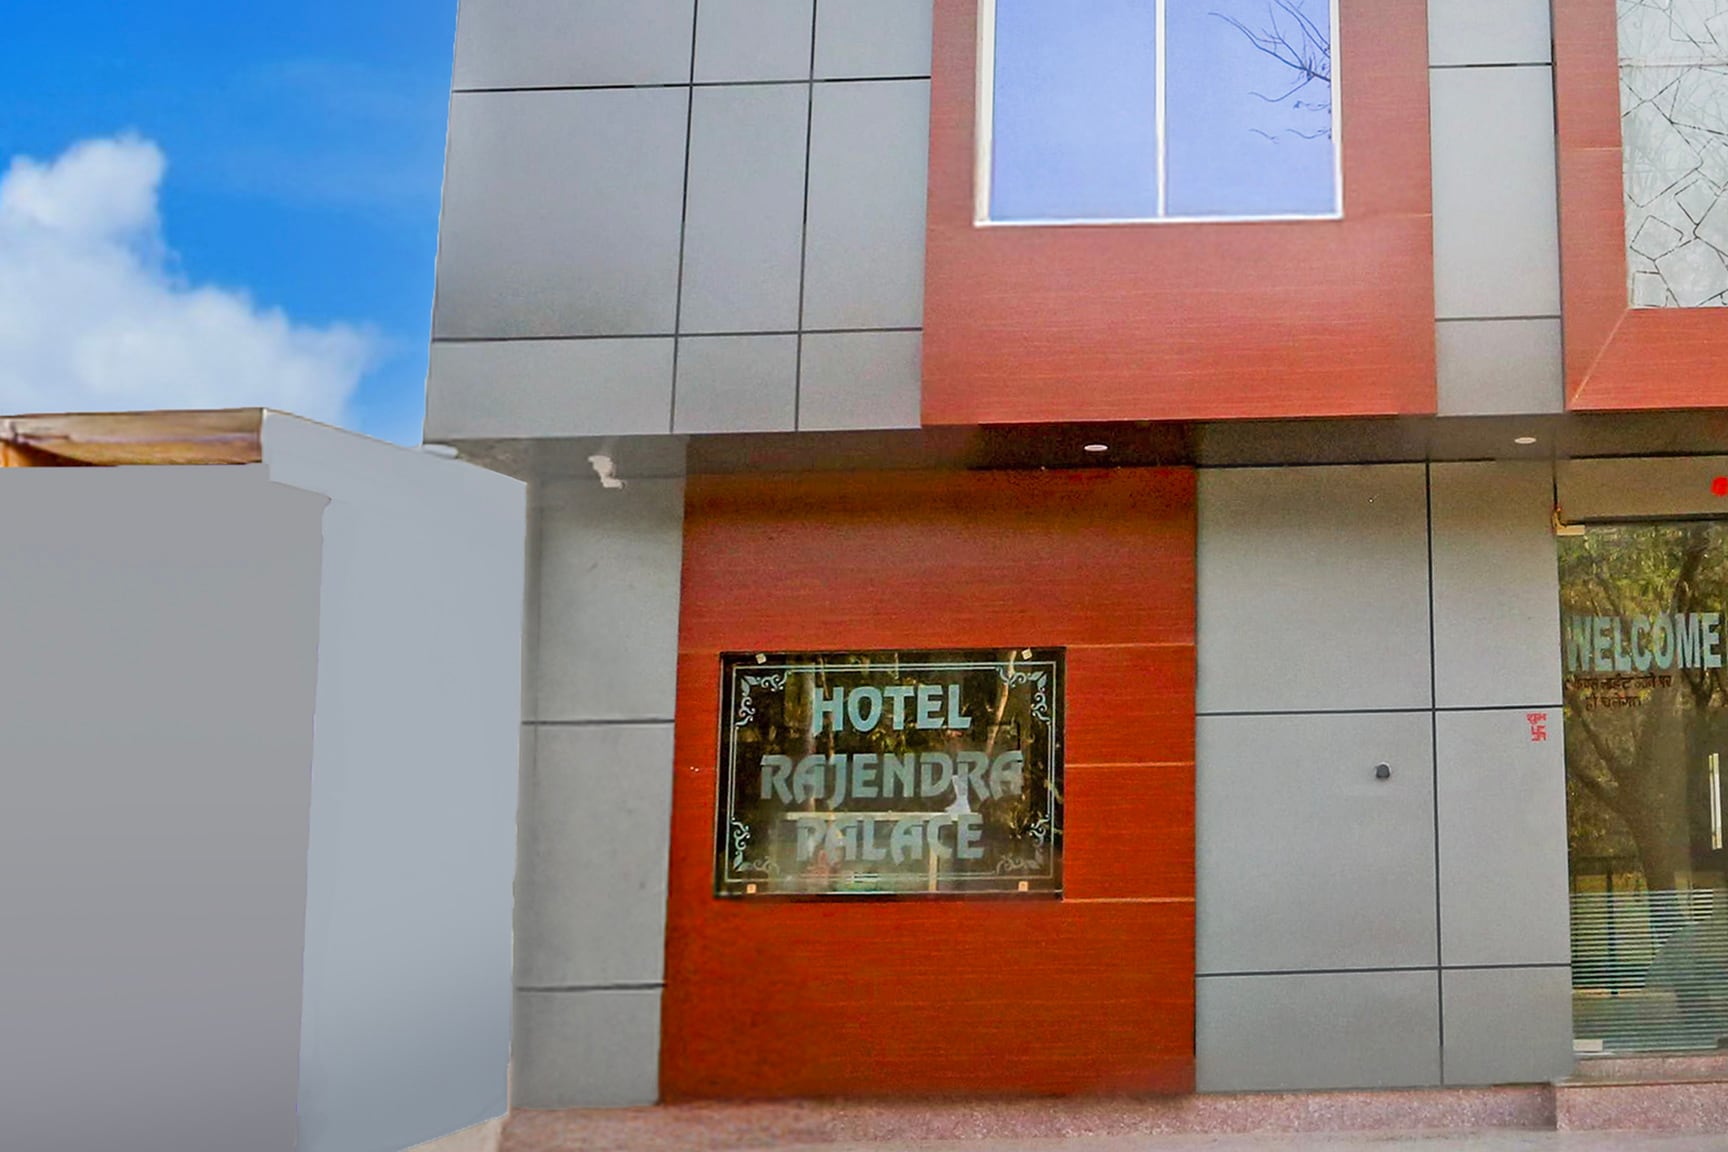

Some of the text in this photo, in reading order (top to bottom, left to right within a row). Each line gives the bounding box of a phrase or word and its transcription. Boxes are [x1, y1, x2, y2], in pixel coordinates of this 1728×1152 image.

[1565, 611, 1722, 672] WELCOME
[812, 684, 972, 736] HOTEL
[760, 749, 1024, 810] RAJENDRA
[796, 813, 985, 866] PALACE
